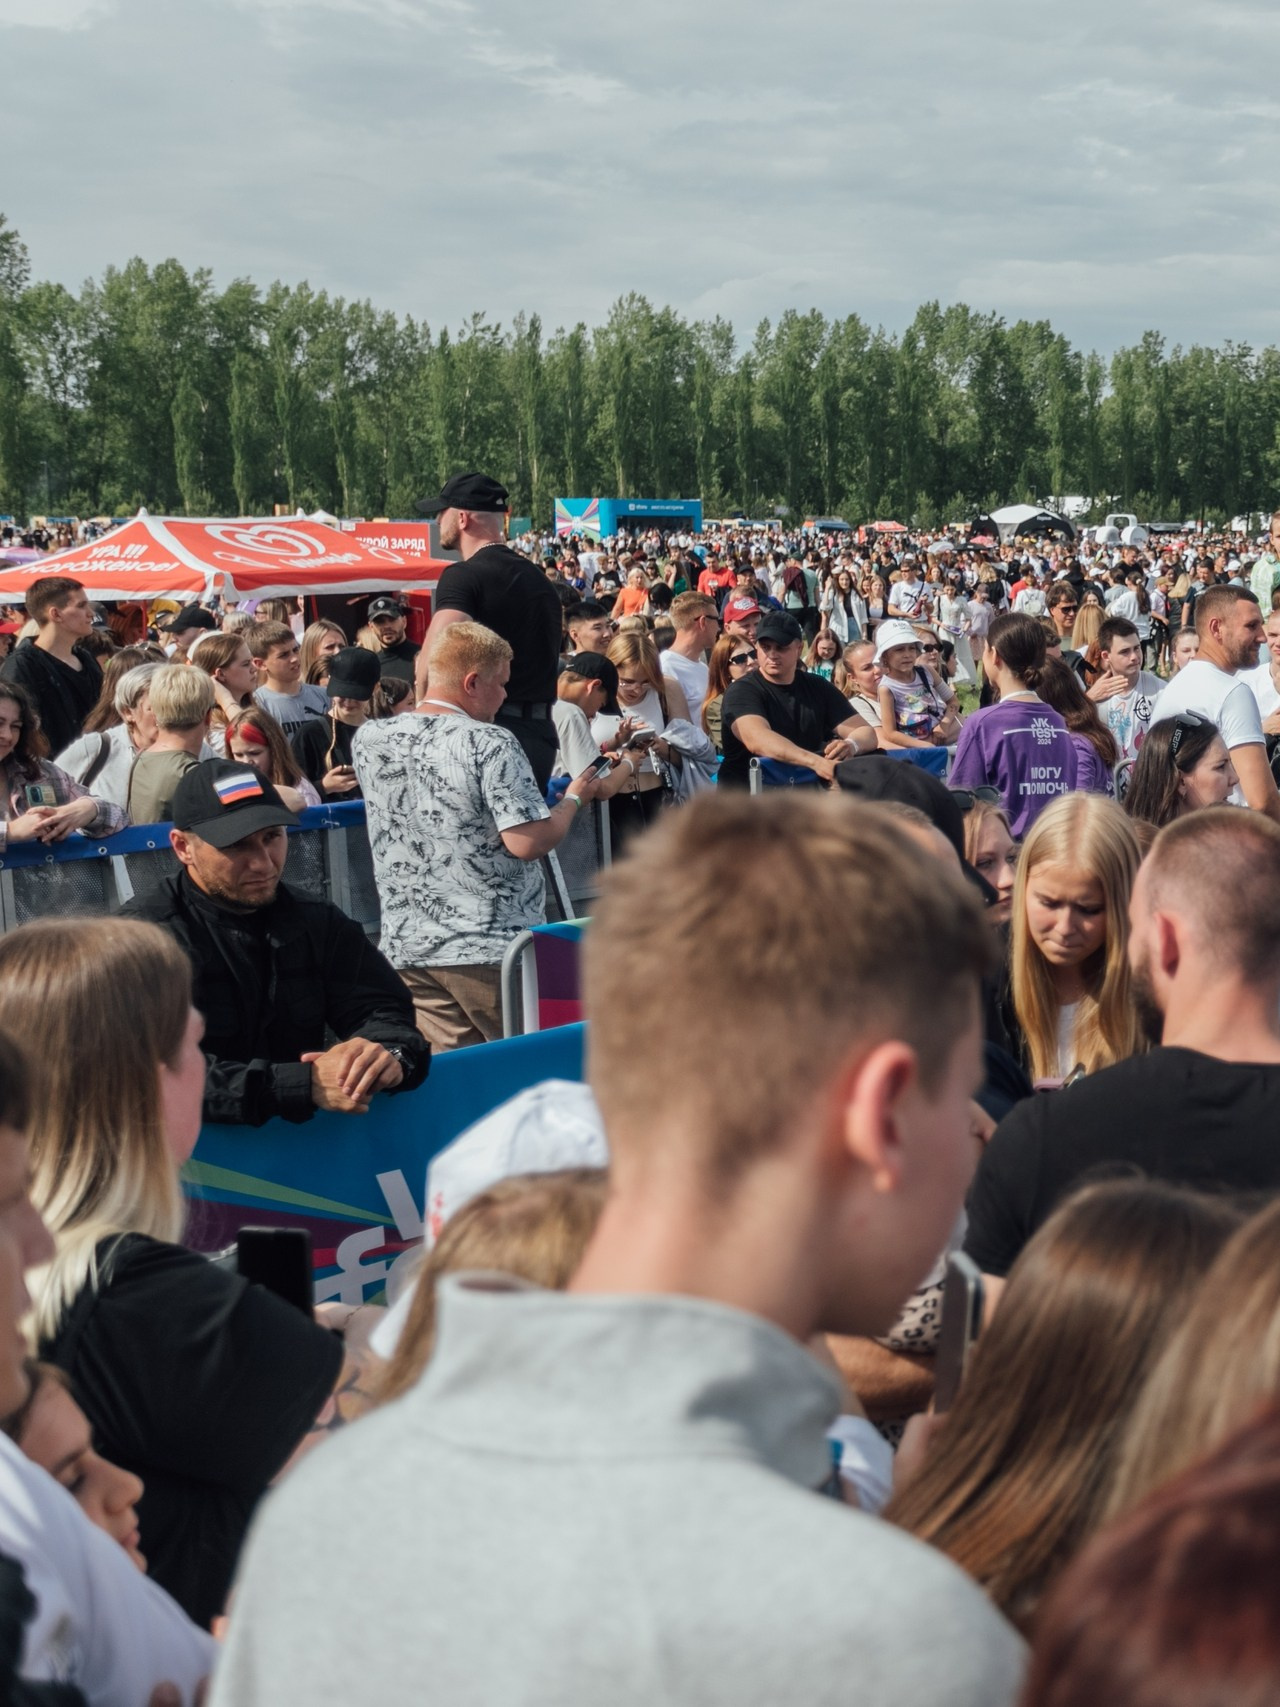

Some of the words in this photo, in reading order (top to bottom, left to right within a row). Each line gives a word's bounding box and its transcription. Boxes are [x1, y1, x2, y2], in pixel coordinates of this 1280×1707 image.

[355, 535, 389, 549] РОЙ
[391, 538, 426, 551] ЗАРЯД
[1032, 718, 1050, 728] VK
[1031, 767, 1062, 779] МОГУ
[1019, 782, 1069, 796] ПОМОЧЬ
